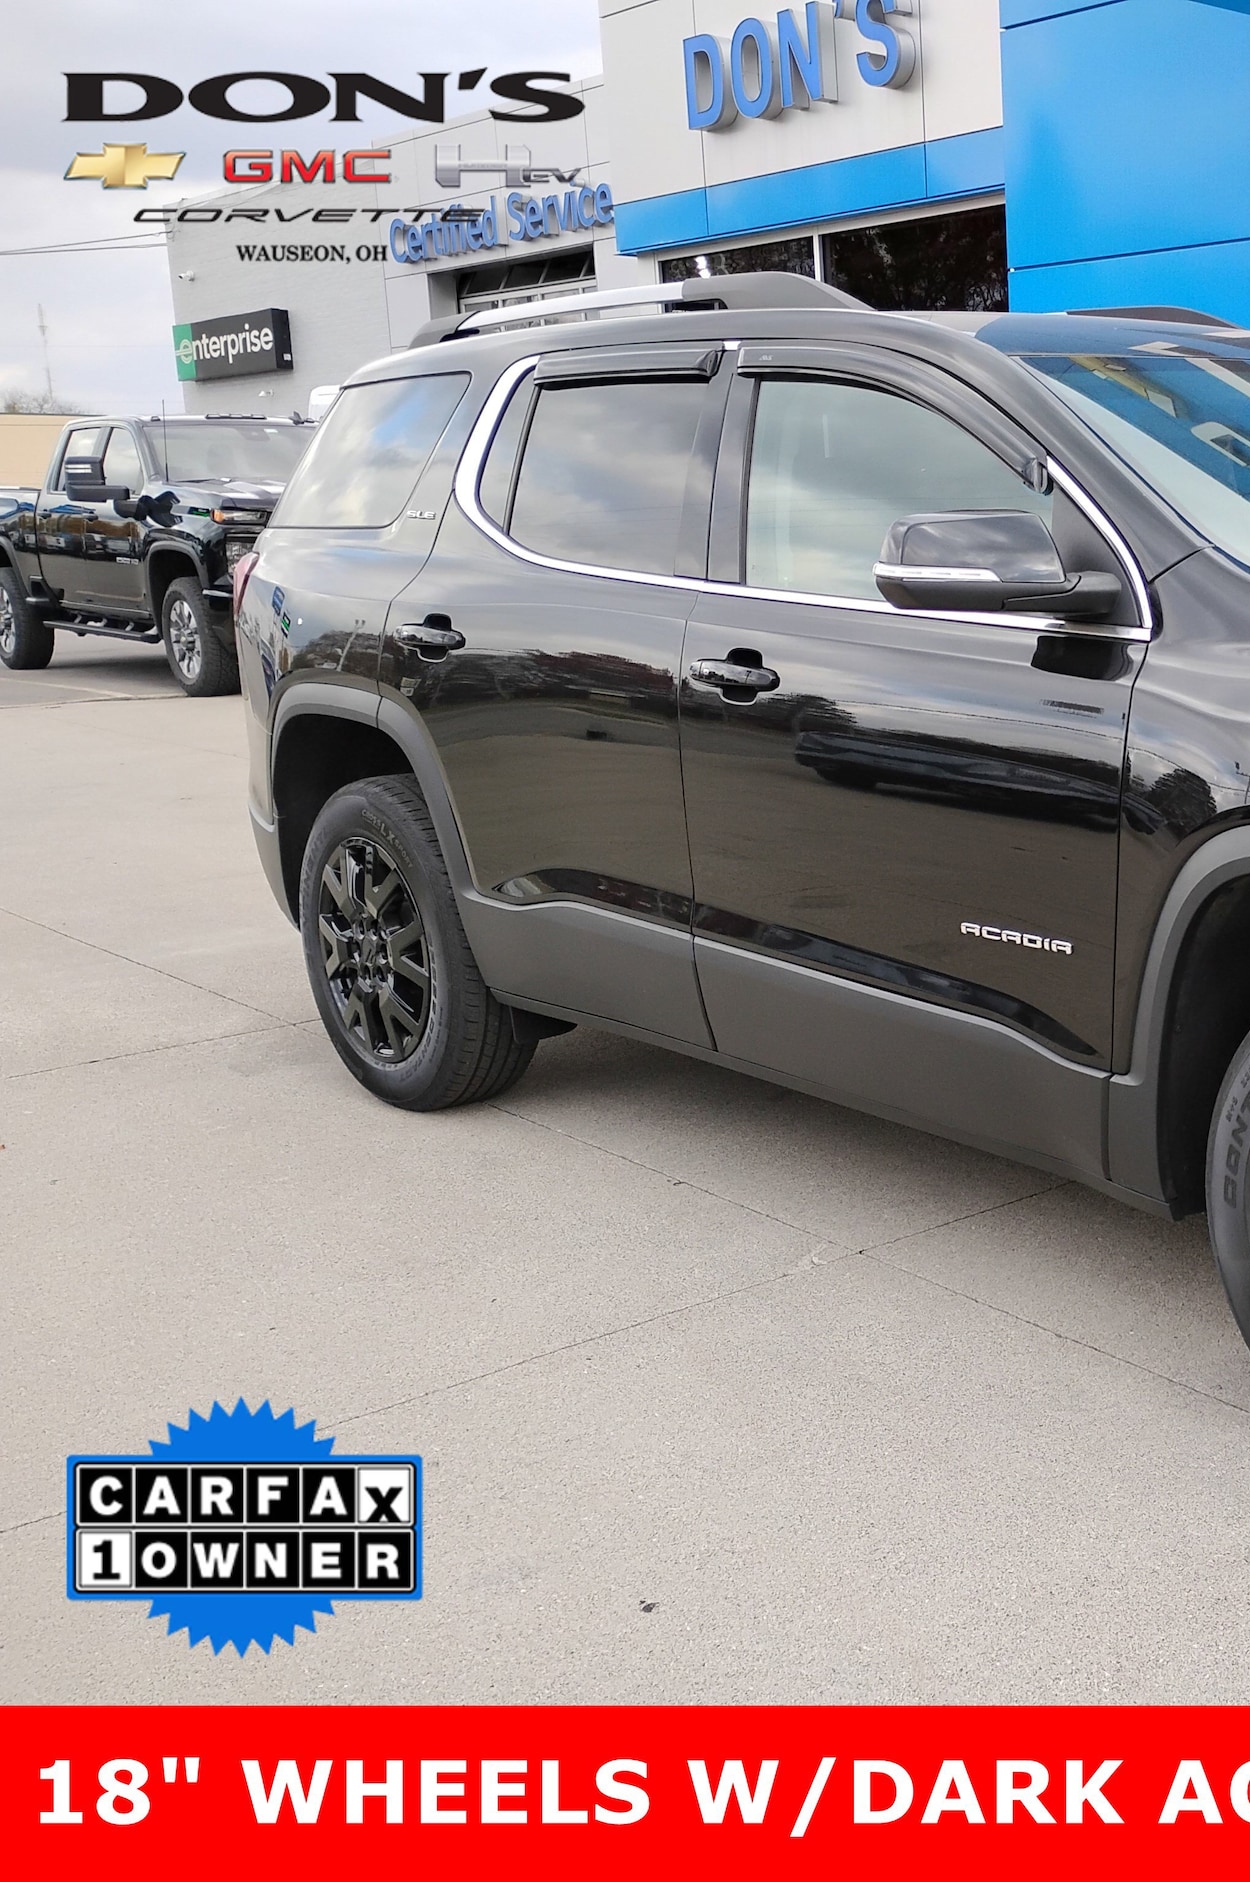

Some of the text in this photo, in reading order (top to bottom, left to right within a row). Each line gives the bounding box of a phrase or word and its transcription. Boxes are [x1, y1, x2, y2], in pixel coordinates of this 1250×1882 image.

[506, 182, 614, 241] Service
[176, 323, 273, 365] enterprise
[407, 510, 436, 520] SLE
[960, 921, 1073, 955] ACADIA
